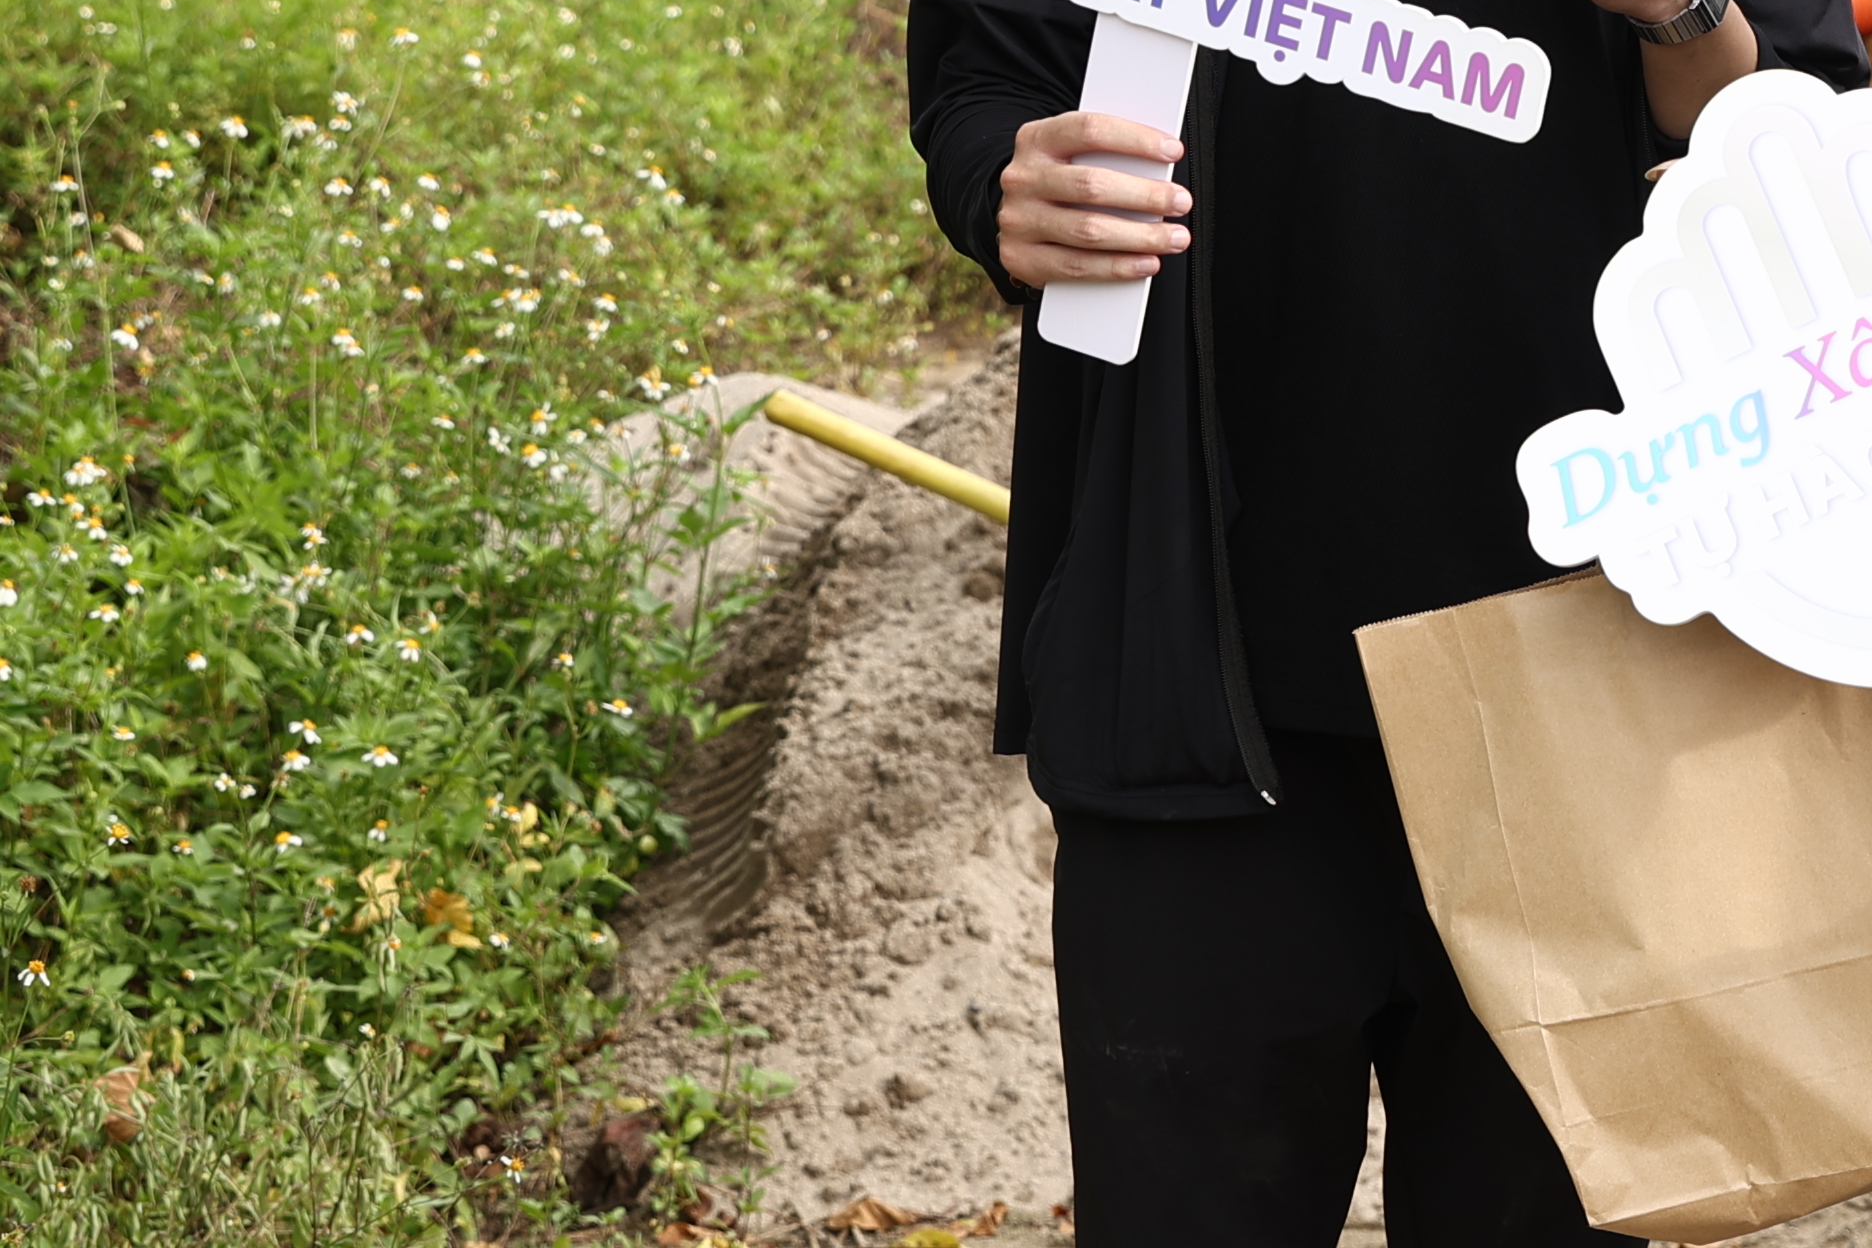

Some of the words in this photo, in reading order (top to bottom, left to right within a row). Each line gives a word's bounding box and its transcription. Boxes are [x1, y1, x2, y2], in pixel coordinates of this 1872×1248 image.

[1360, 21, 1526, 120] NAM
[1549, 388, 1771, 529] Dựng
[1637, 492, 1738, 588] TỰ
